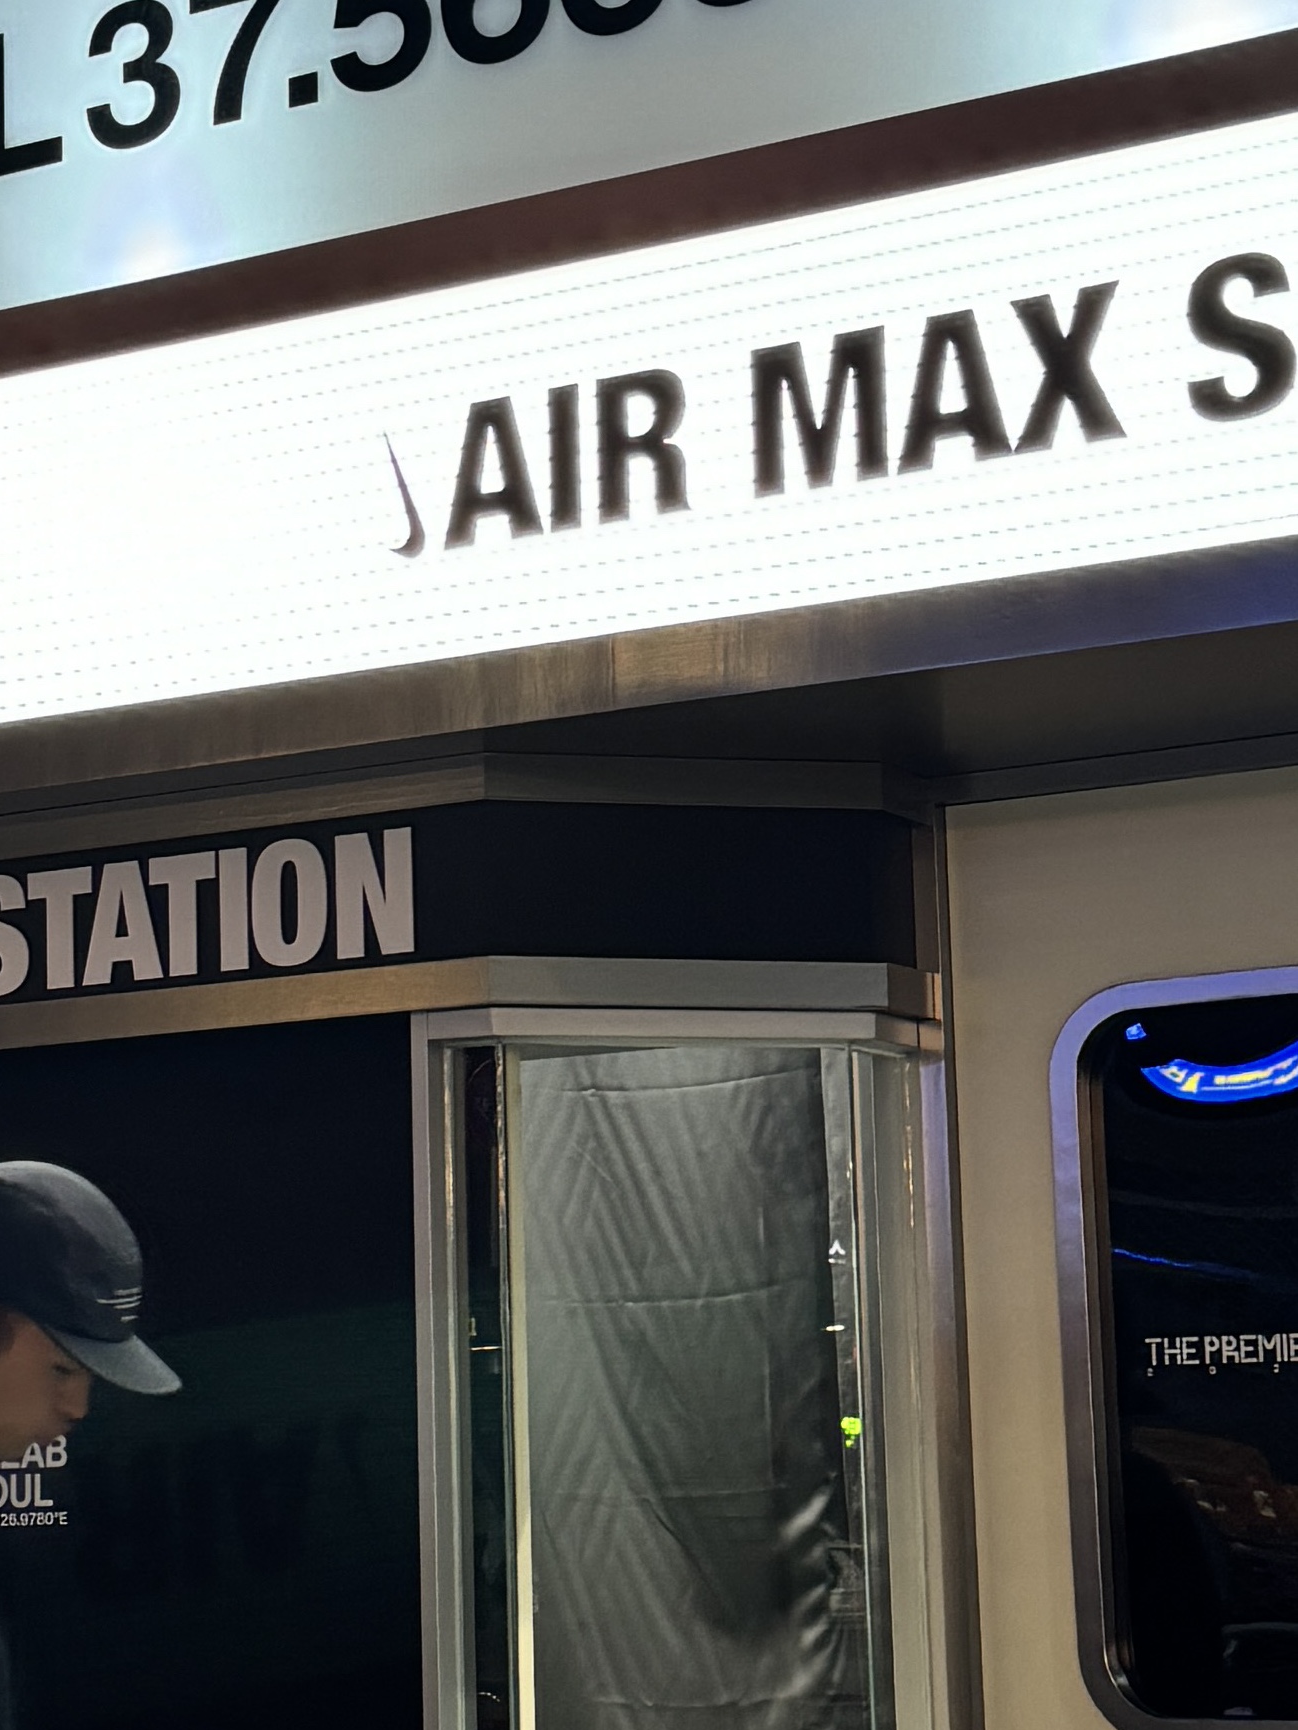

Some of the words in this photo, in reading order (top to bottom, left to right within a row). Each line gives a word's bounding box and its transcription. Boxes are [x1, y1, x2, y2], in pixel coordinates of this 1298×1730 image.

[86, 0, 752, 150] 37.5
[444, 368, 691, 550] AIR
[750, 280, 1127, 499] MAX
[1186, 252, 1297, 422] S
[1144, 1336, 1200, 1366] THE
